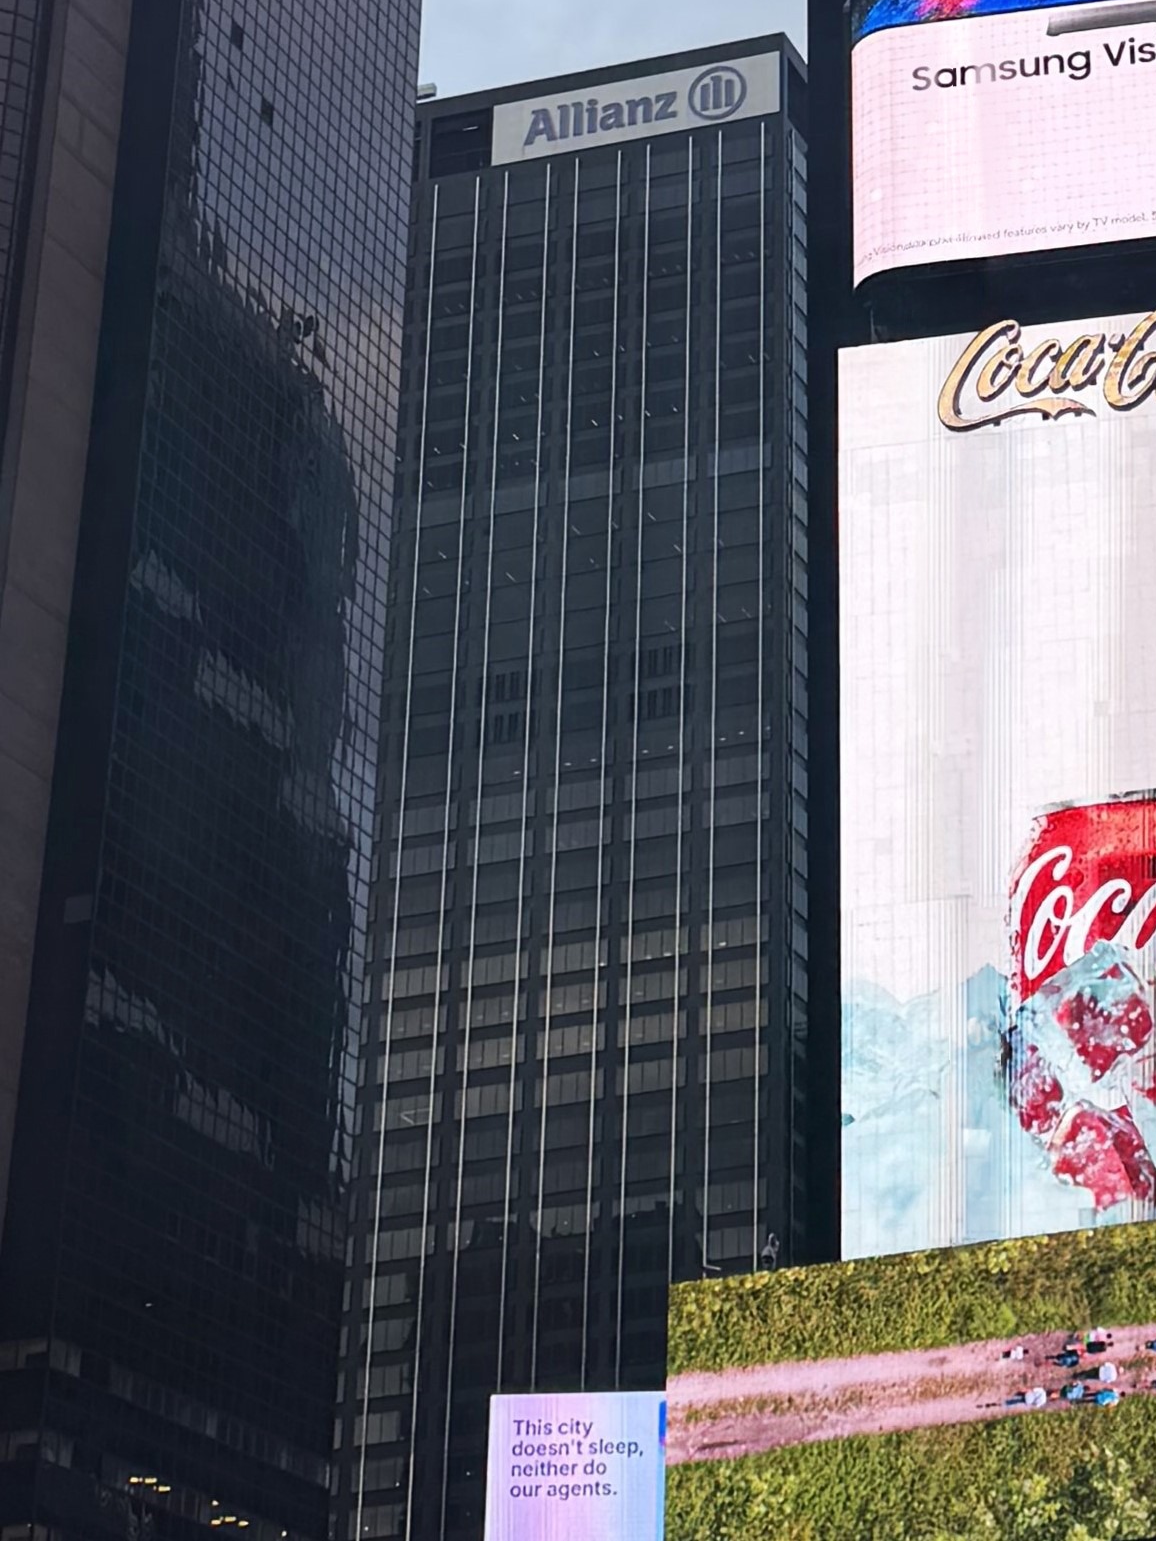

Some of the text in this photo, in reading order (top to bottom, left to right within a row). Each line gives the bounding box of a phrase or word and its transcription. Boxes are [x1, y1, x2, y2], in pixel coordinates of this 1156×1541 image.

[911, 48, 1092, 92] Samsung
[523, 91, 678, 146] Allianz
[513, 1417, 593, 1439] This city
[512, 1438, 644, 1459] doesn't sleep,
[511, 1459, 607, 1478] neither do
[510, 1481, 618, 1502] our agents.
